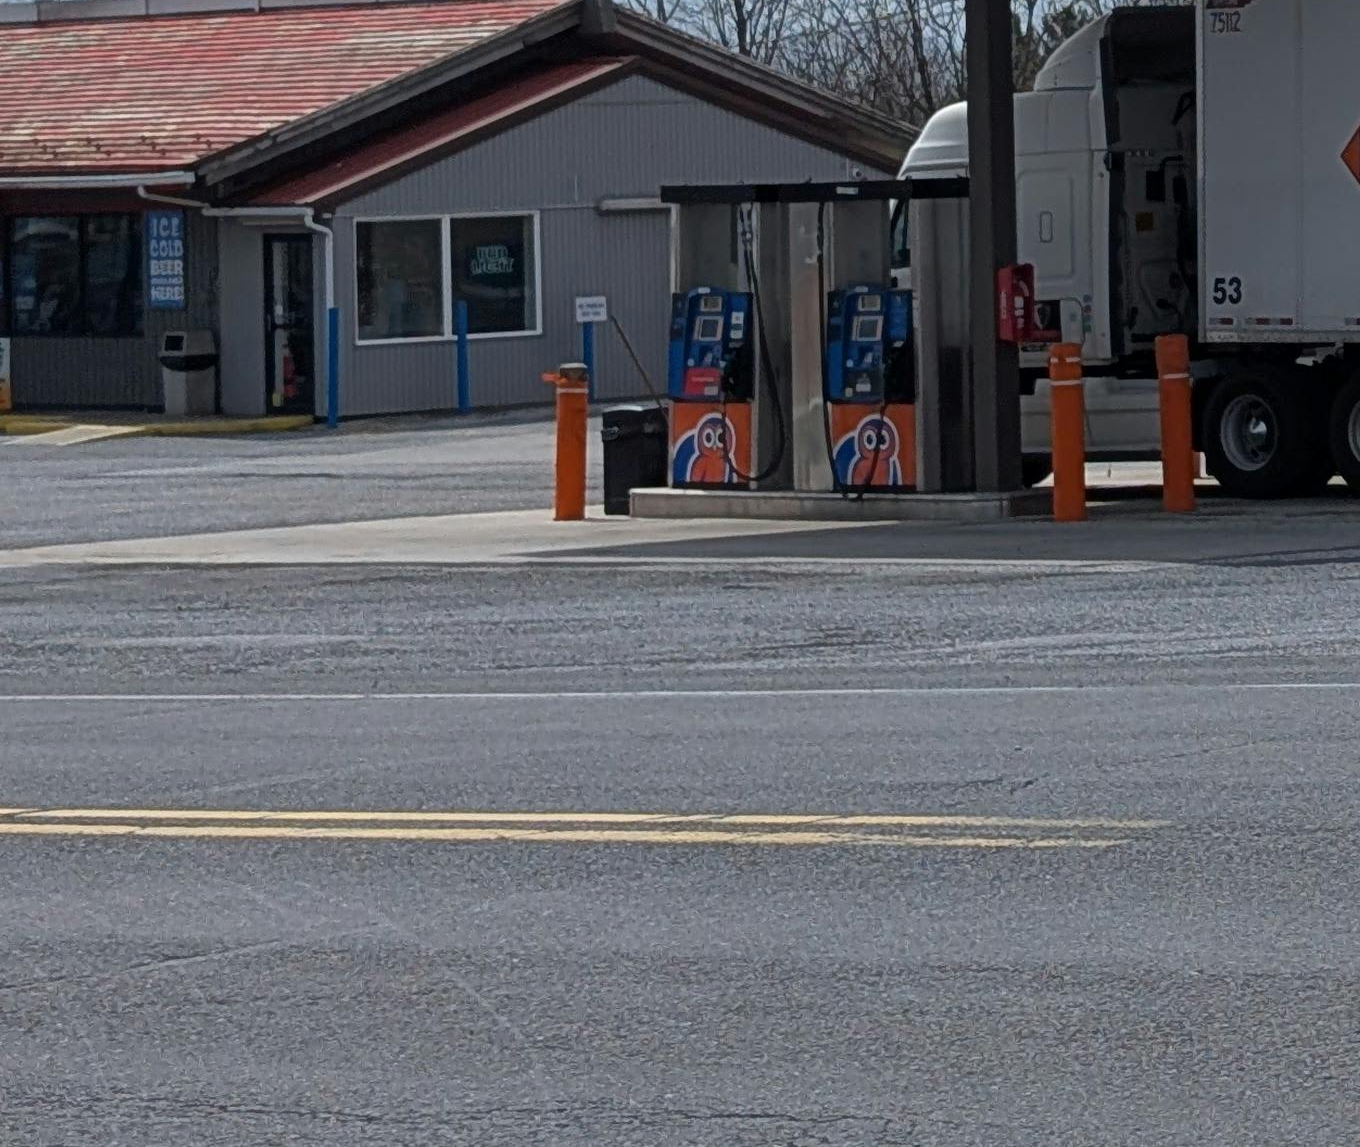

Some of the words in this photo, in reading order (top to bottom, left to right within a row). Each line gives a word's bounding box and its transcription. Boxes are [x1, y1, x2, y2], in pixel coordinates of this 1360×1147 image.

[1210, 11, 1241, 33] 75112
[150, 239, 184, 258] COLD
[1213, 276, 1242, 304] 53
